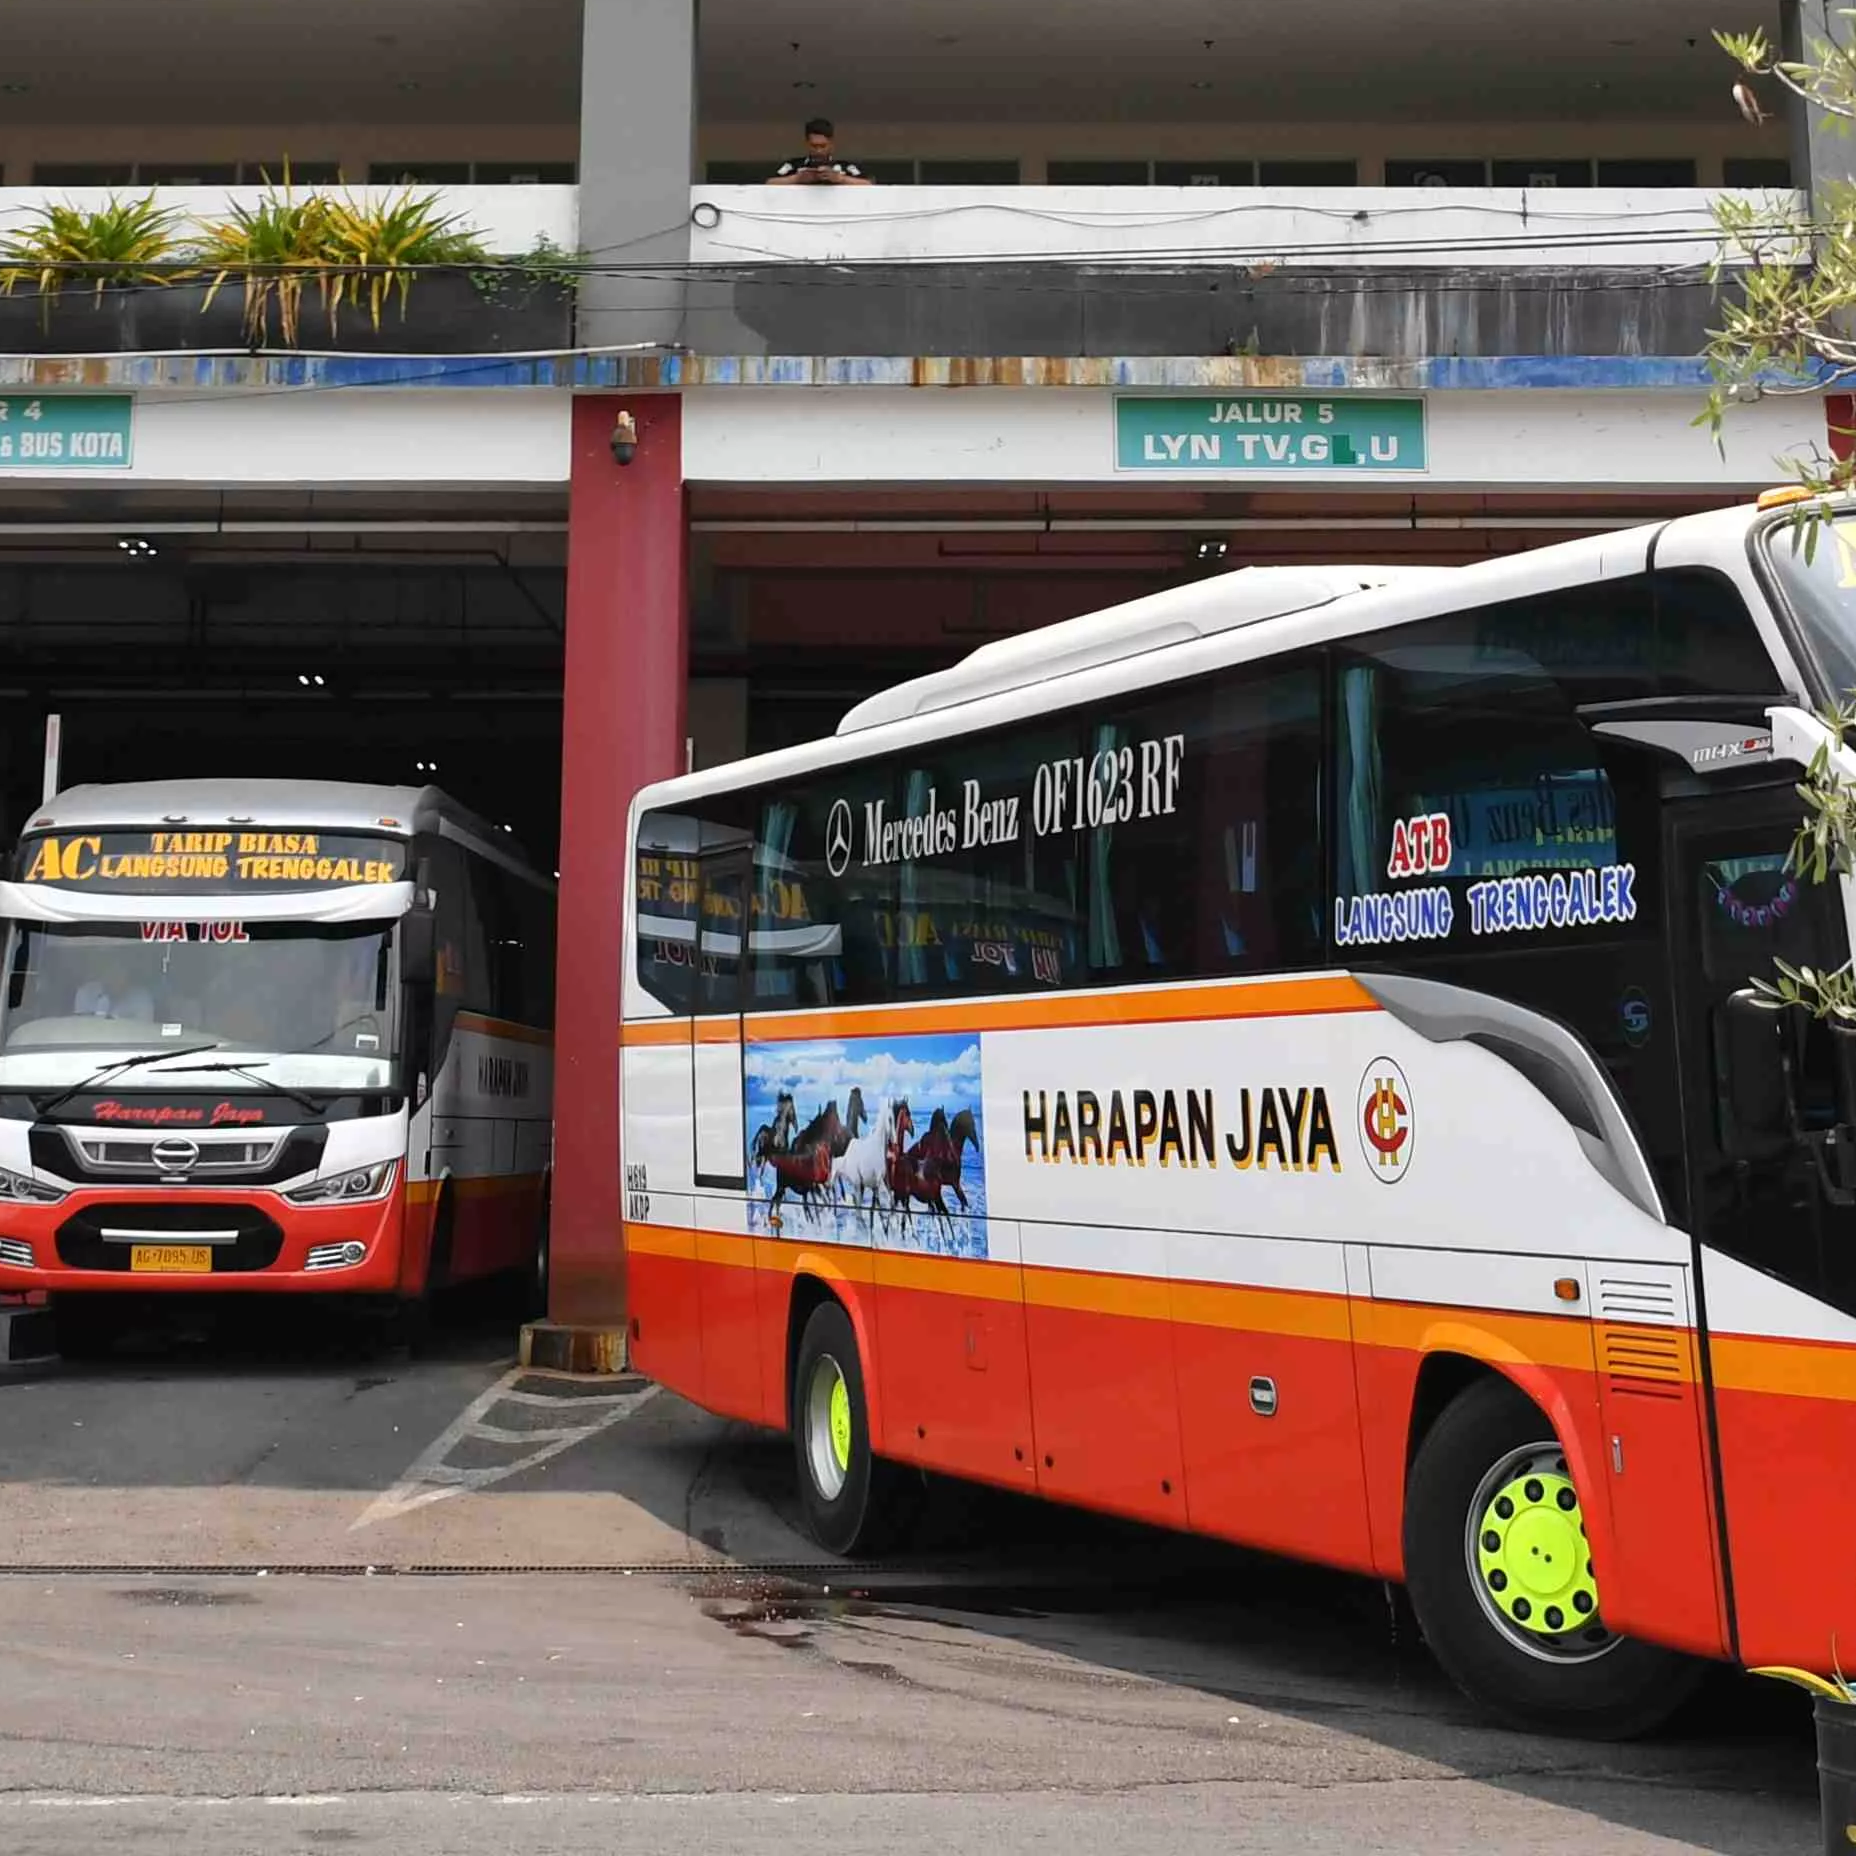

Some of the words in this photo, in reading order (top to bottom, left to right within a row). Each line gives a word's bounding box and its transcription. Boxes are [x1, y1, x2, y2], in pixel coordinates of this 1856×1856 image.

[24, 401, 43, 421] 4
[1208, 403, 1303, 424] JALUR
[1318, 404, 1334, 424] 5
[0, 435, 13, 458] &
[20, 431, 63, 458] BUS
[69, 432, 124, 458] KOTA
[1144, 434, 1221, 461] LYN
[862, 787, 957, 866] Mercedes
[961, 778, 1020, 849] Benz
[150, 833, 232, 854] TARIP
[238, 834, 319, 855] BIASA
[1388, 812, 1453, 878] ATB
[24, 835, 101, 882] AC
[100, 855, 228, 879] LANGSUNG
[236, 857, 394, 884] TRENGGALEK
[1335, 886, 1455, 946] LANGSUNG
[1467, 863, 1637, 935] TRENGGALEK
[139, 920, 191, 943] VIA
[199, 920, 250, 943] TOL
[93, 1099, 204, 1124] Harapan
[208, 1101, 264, 1125] Jaya
[1022, 1088, 1217, 1170] HARAPAN
[1224, 1086, 1343, 1174] JAYA
[191, 1247, 208, 1264] US
